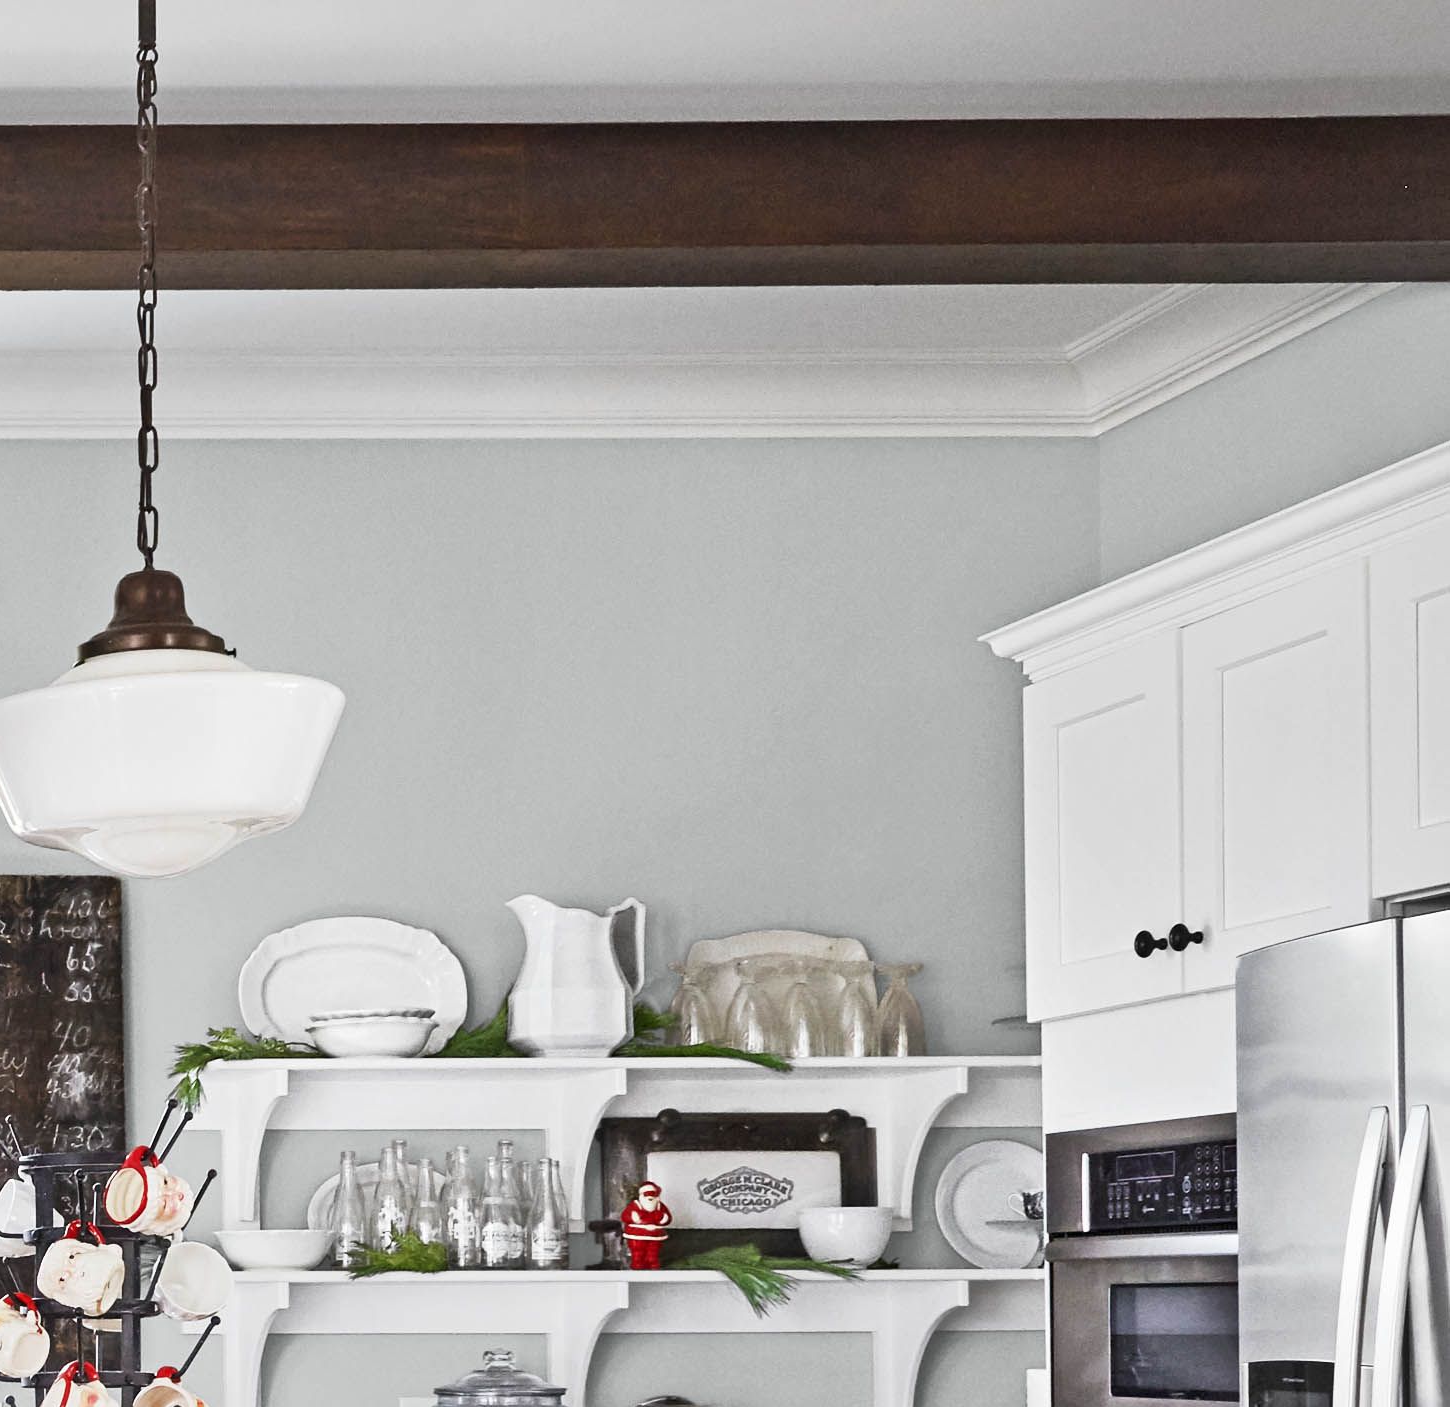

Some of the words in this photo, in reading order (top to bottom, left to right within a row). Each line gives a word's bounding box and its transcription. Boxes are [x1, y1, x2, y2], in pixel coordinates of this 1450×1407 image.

[66, 943, 102, 973] 65
[52, 1020, 91, 1050] 40
[702, 1176, 741, 1195] GEORGE
[754, 1176, 788, 1194] CLARK
[722, 1184, 771, 1195] COMPANY
[720, 1198, 771, 1206] CHICAGO
